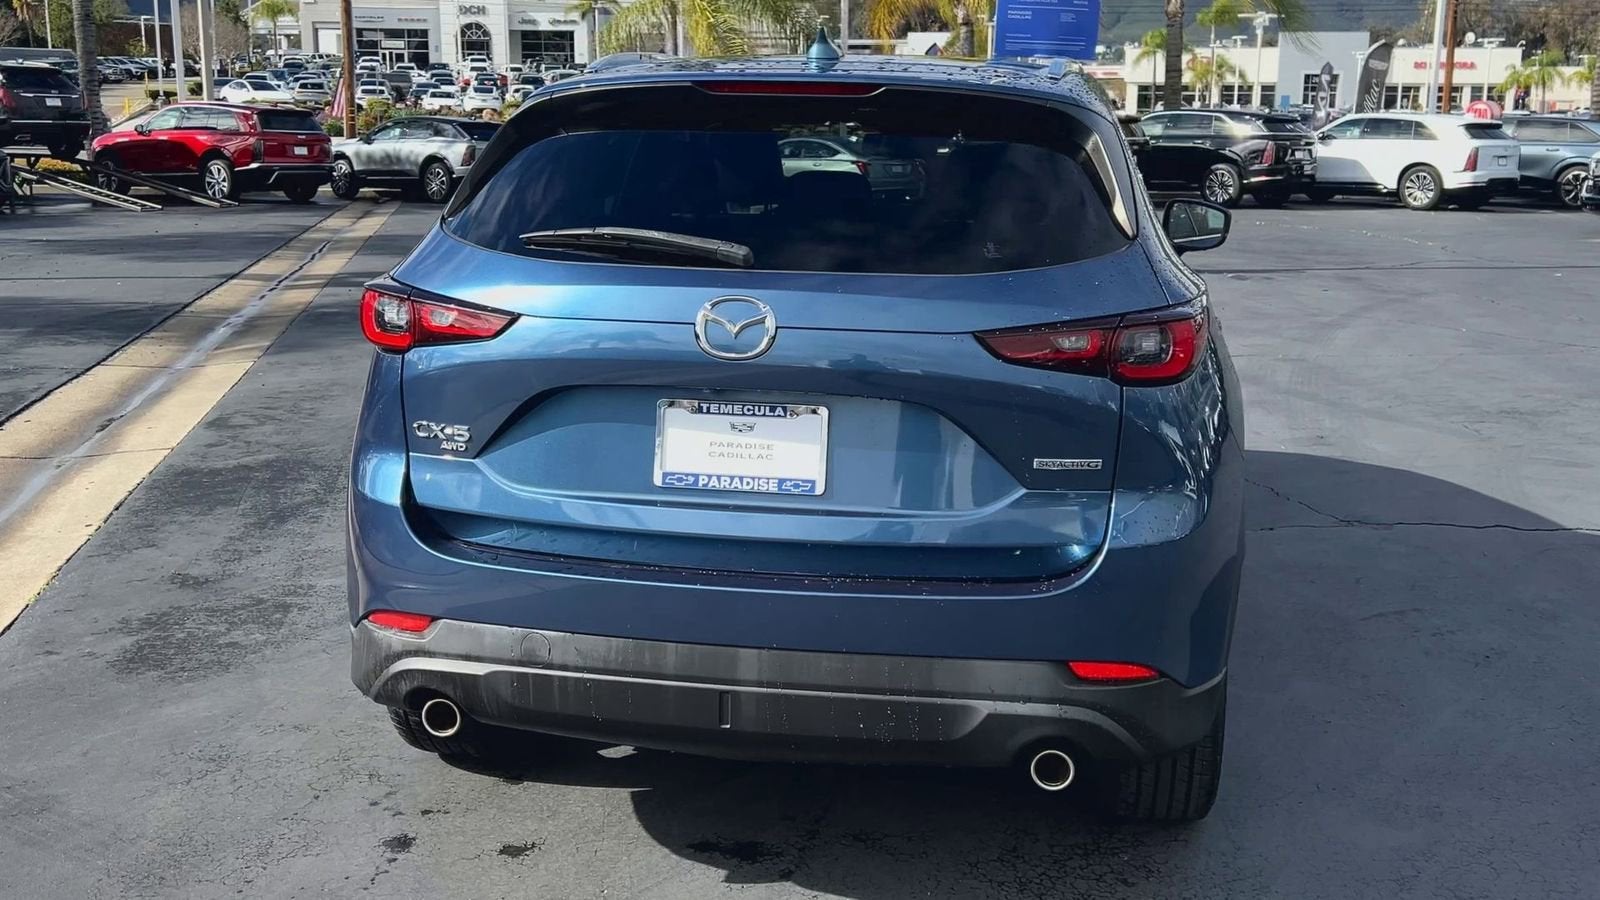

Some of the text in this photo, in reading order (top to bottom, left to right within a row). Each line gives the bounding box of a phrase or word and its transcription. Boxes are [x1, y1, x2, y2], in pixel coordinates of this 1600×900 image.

[700, 403, 785, 417] TEMECULA
[413, 420, 471, 442] CX-5
[440, 440, 467, 452] AWD
[709, 441, 775, 451] PARADISE
[708, 451, 774, 461] CADILLAC
[698, 475, 779, 491] PARADISE
